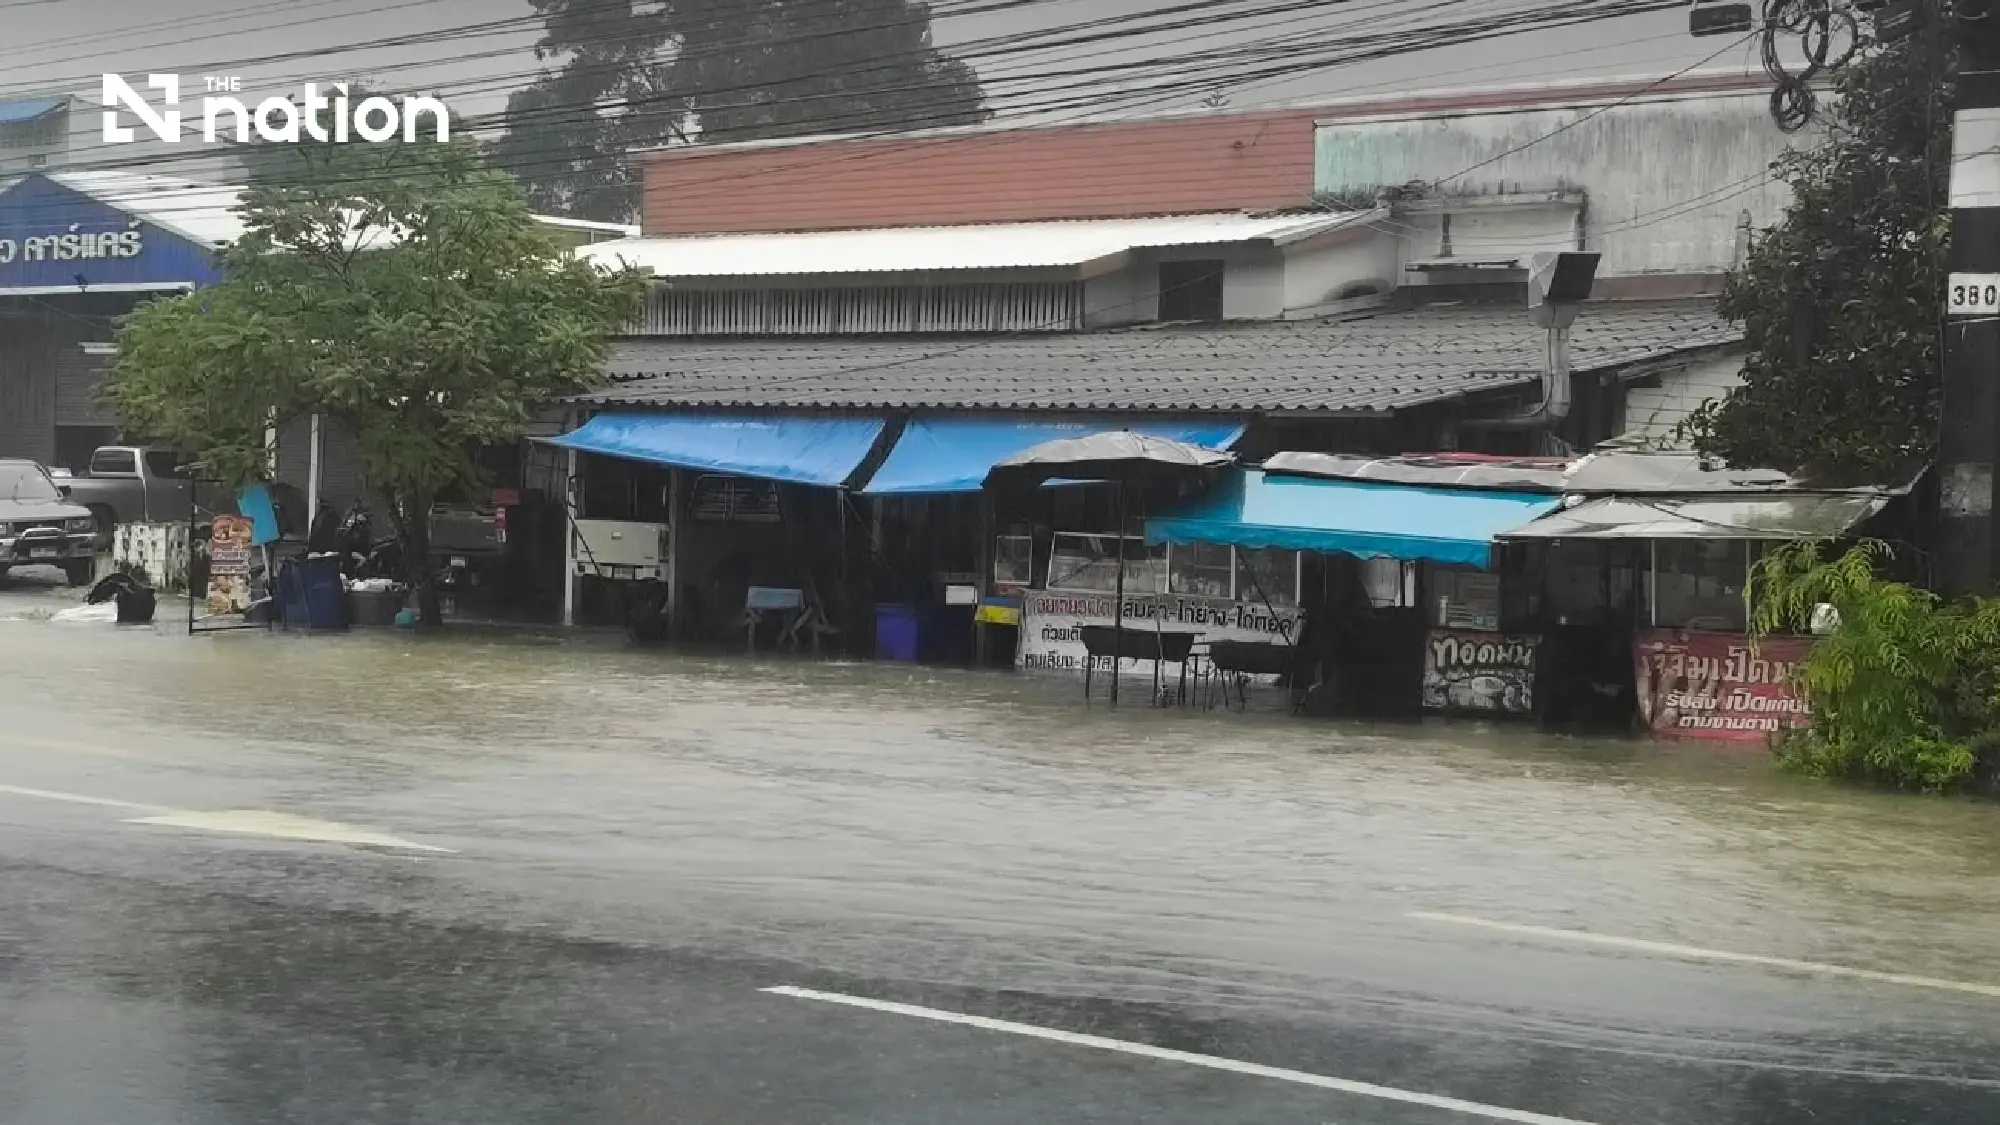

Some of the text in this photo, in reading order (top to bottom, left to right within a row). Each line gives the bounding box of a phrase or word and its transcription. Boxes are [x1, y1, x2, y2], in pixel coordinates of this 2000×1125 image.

[24, 220, 142, 261] คาร์แคร์
[1953, 285, 1997, 306] 380
[1433, 637, 1532, 668] ทอดมัน
